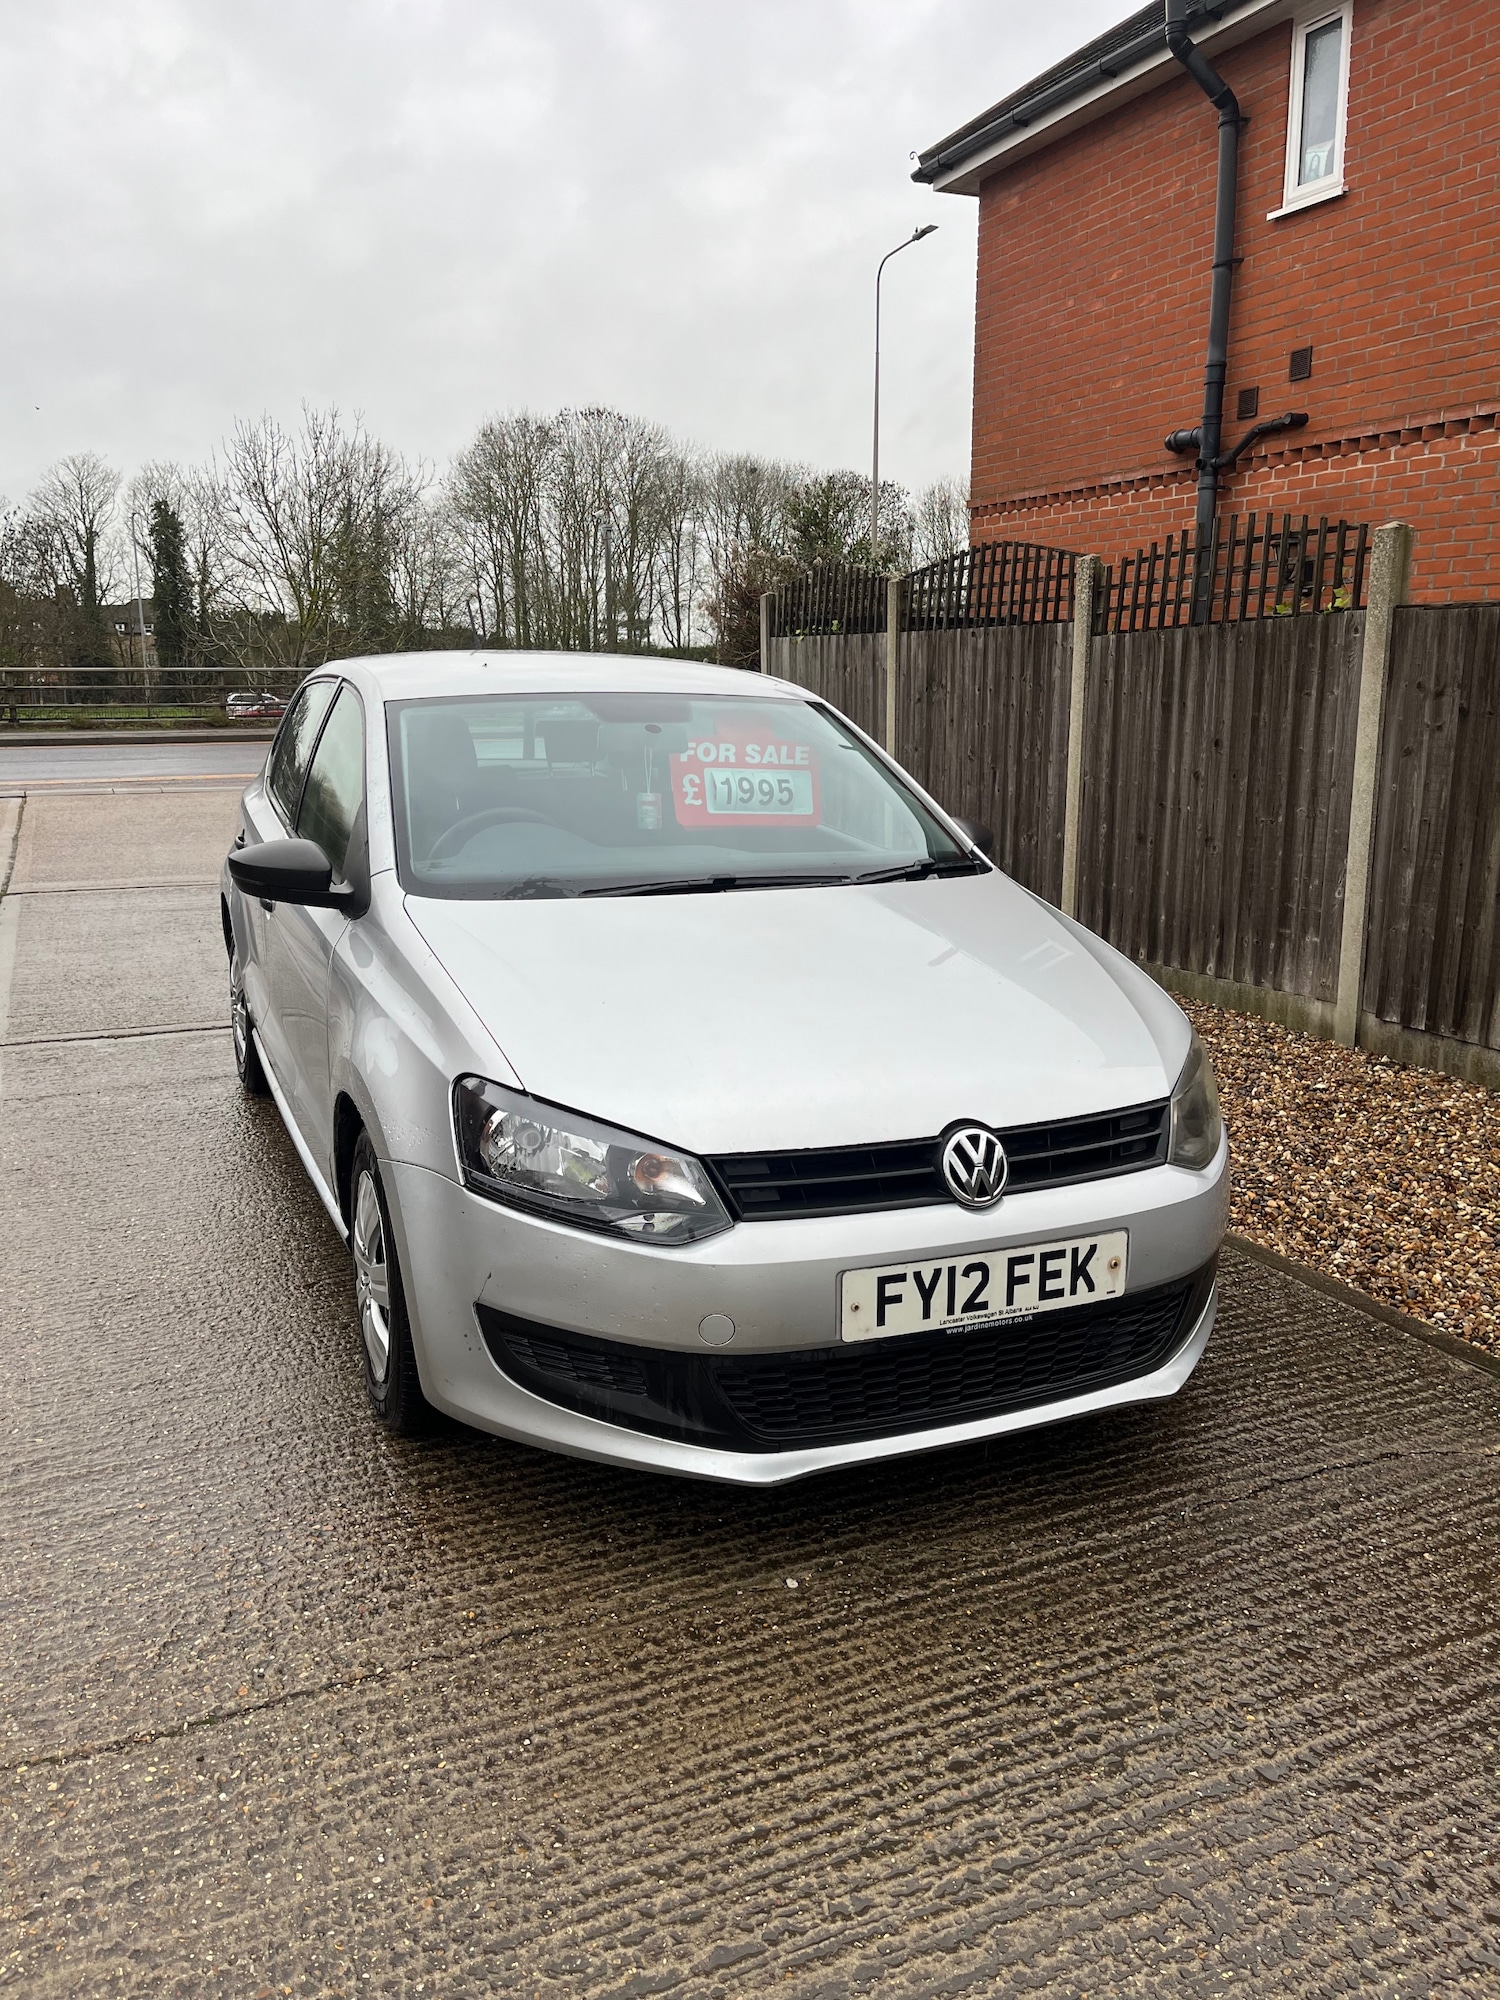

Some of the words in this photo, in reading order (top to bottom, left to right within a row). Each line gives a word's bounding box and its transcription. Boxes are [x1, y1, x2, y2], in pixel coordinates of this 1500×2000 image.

[680, 742, 736, 763] FOR
[745, 743, 810, 765] SALE
[720, 776, 794, 806] 1995
[876, 1261, 990, 1327] FY12
[1005, 1243, 1098, 1307] FEK
[946, 1314, 1034, 1334] www.jardinemotors.co.uk
[966, 1310, 998, 1321] Volkswagen
